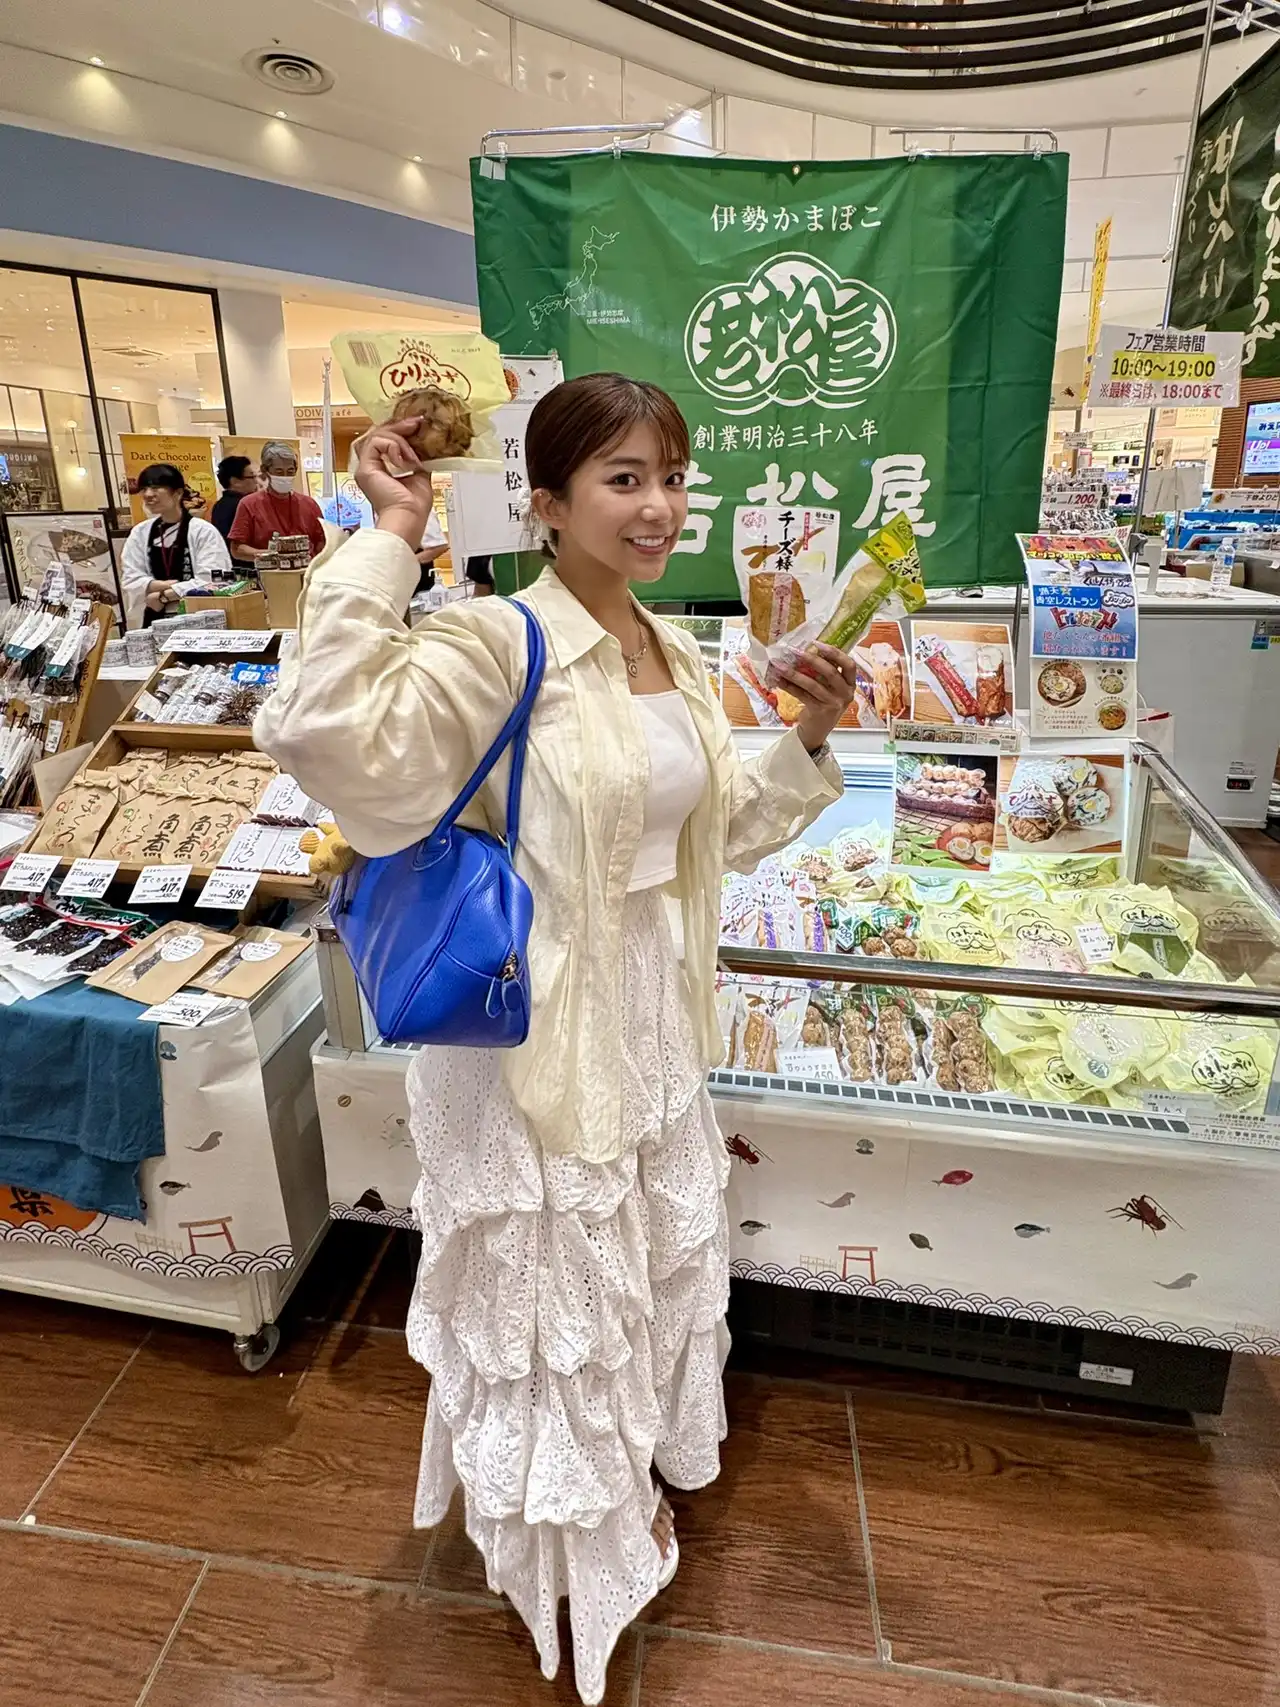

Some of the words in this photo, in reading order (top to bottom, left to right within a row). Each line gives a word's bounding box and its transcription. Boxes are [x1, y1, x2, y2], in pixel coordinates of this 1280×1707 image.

[710, 204, 882, 233] 伊勢かまぼこ
[1125, 333, 1206, 352] フェア営業時間
[693, 418, 879, 452] 創業明治三十八年
[130, 451, 156, 461] Dark
[158, 452, 207, 462] Chocolate
[502, 438, 523, 523] 若松屋
[777, 510, 796, 572] チーズ棒
[1035, 596, 1099, 607] 青空レストラン
[173, 815, 213, 859] 角煮
[1198, 1055, 1253, 1078] はんぺい
